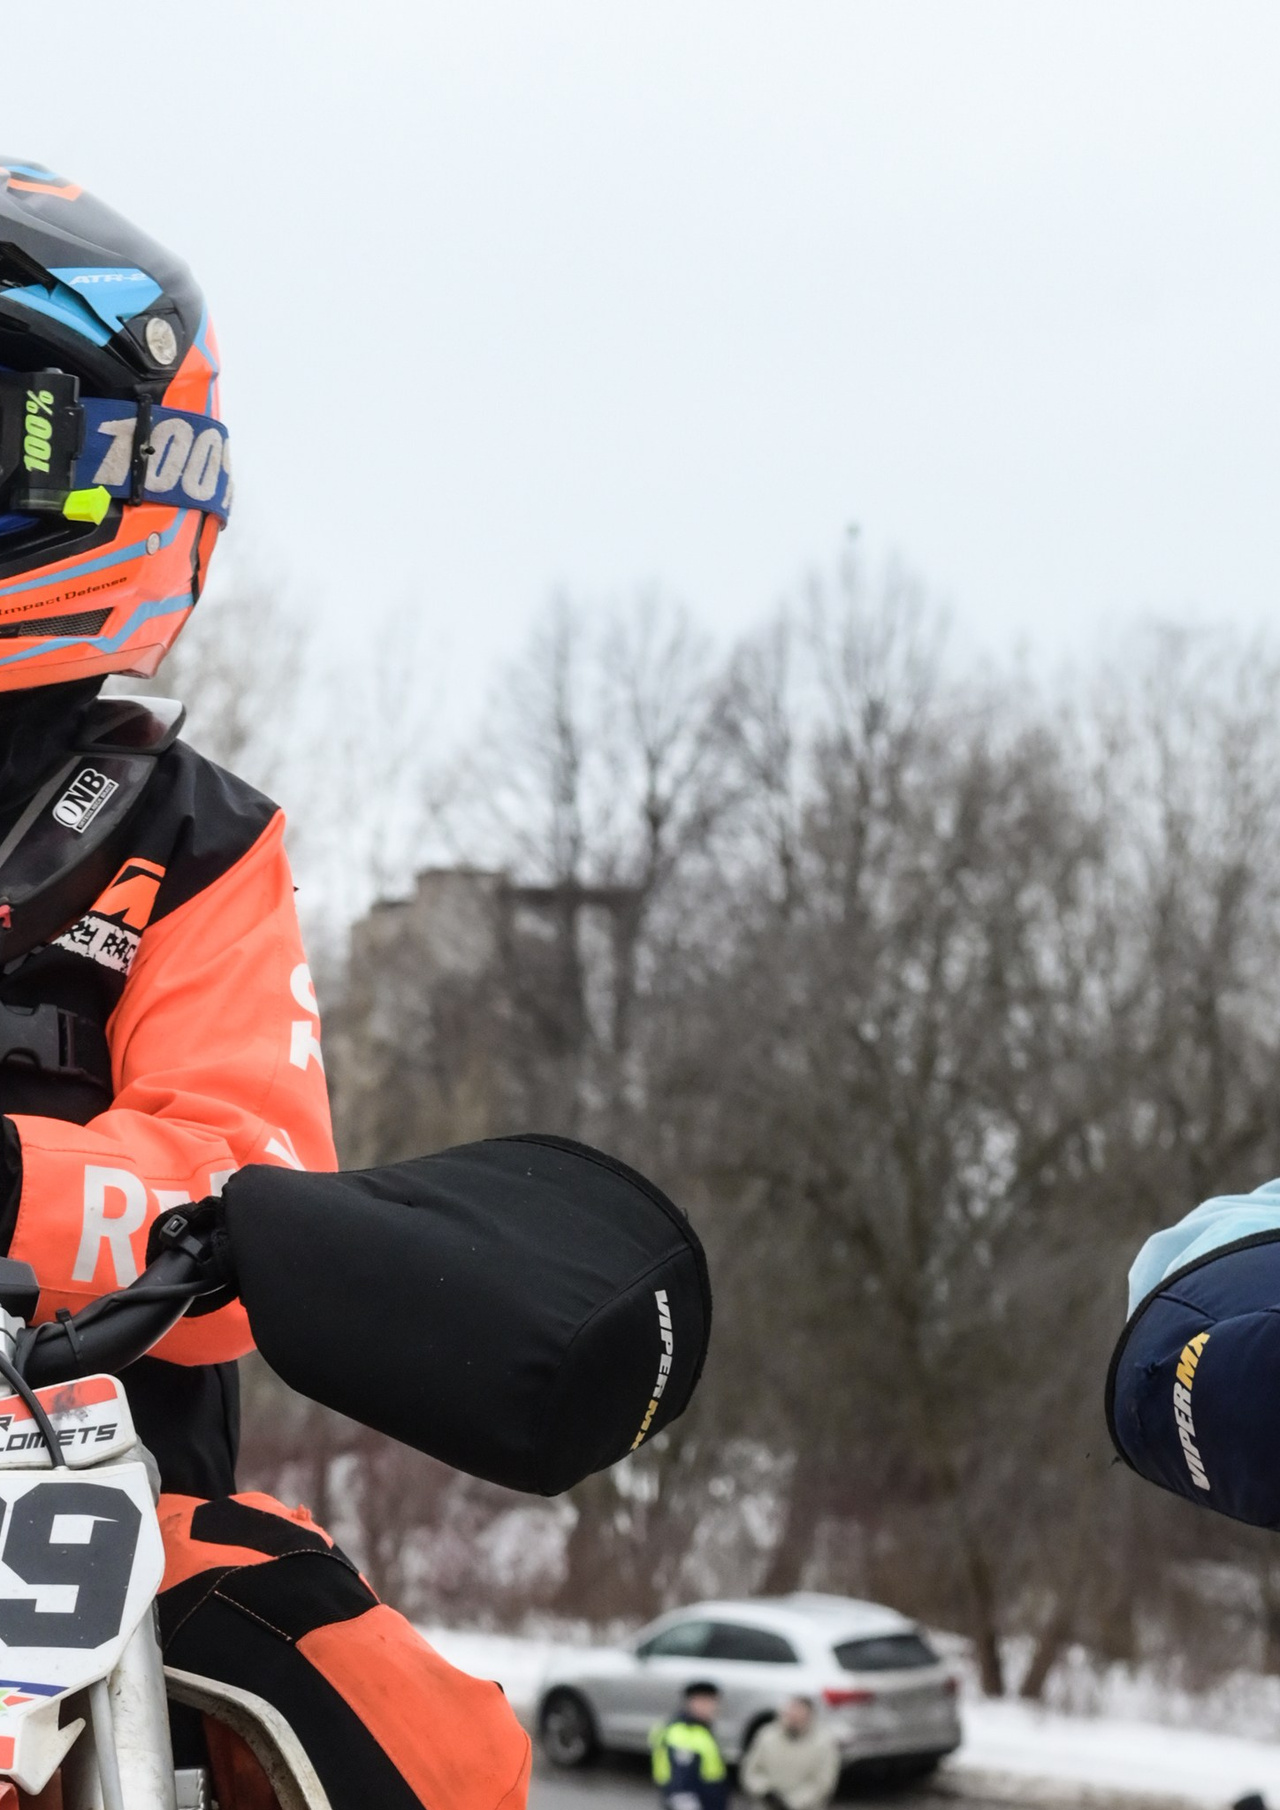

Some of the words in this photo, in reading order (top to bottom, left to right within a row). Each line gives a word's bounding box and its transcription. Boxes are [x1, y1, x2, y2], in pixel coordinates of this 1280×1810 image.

[70, 272, 148, 286] ATR-2
[23, 390, 55, 473] 100%
[91, 416, 233, 511] 100
[64, 576, 128, 600] Defense
[52, 768, 108, 828] ONB
